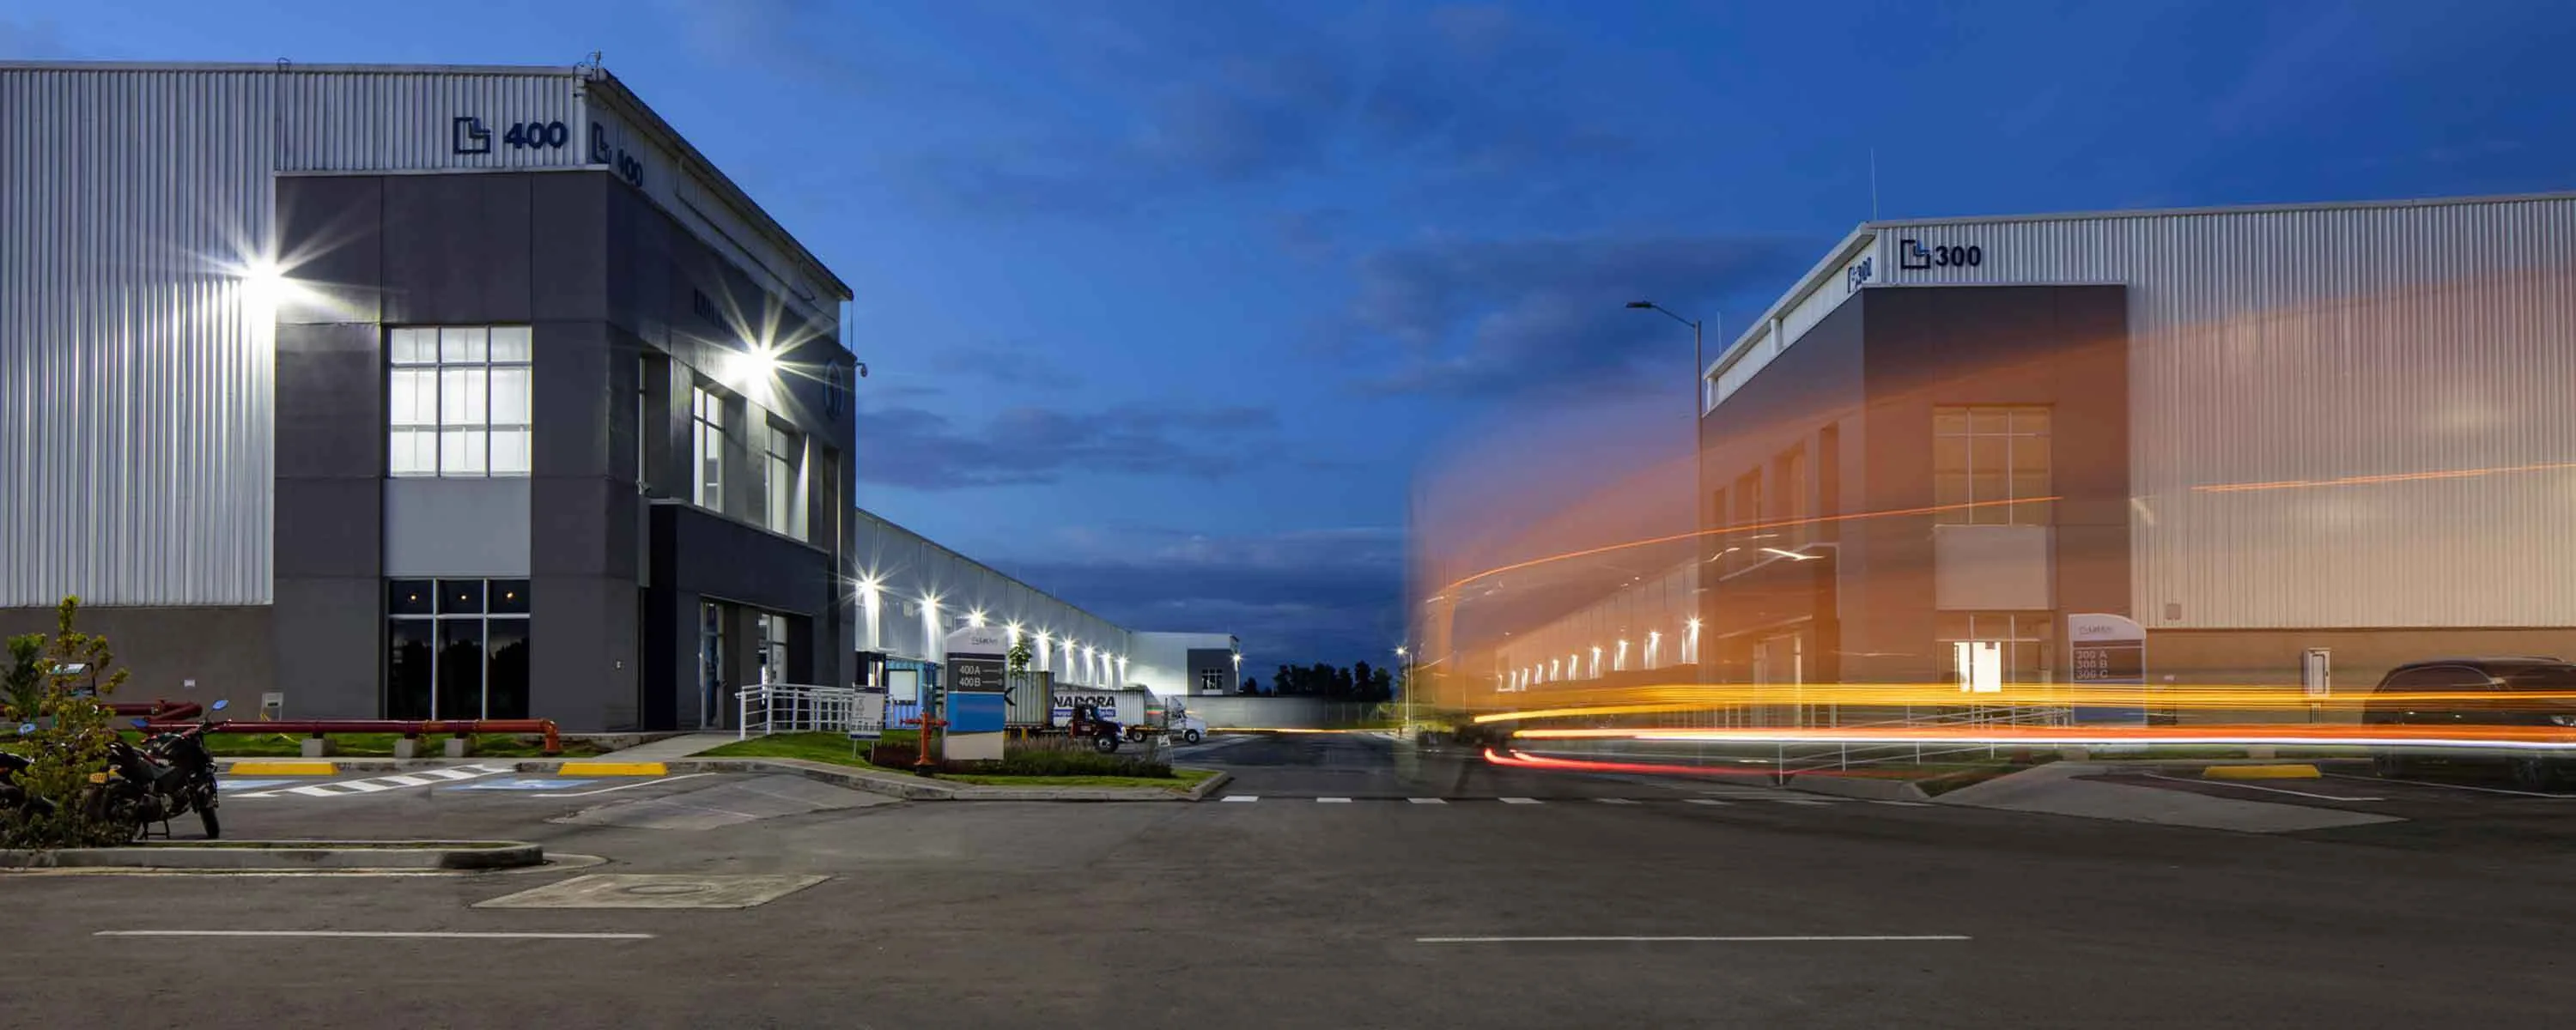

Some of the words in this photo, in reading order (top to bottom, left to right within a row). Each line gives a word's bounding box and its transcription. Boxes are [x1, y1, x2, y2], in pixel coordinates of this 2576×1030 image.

[504, 121, 568, 149] 400
[617, 148, 644, 188] 400
[1935, 245, 1982, 267] 300
